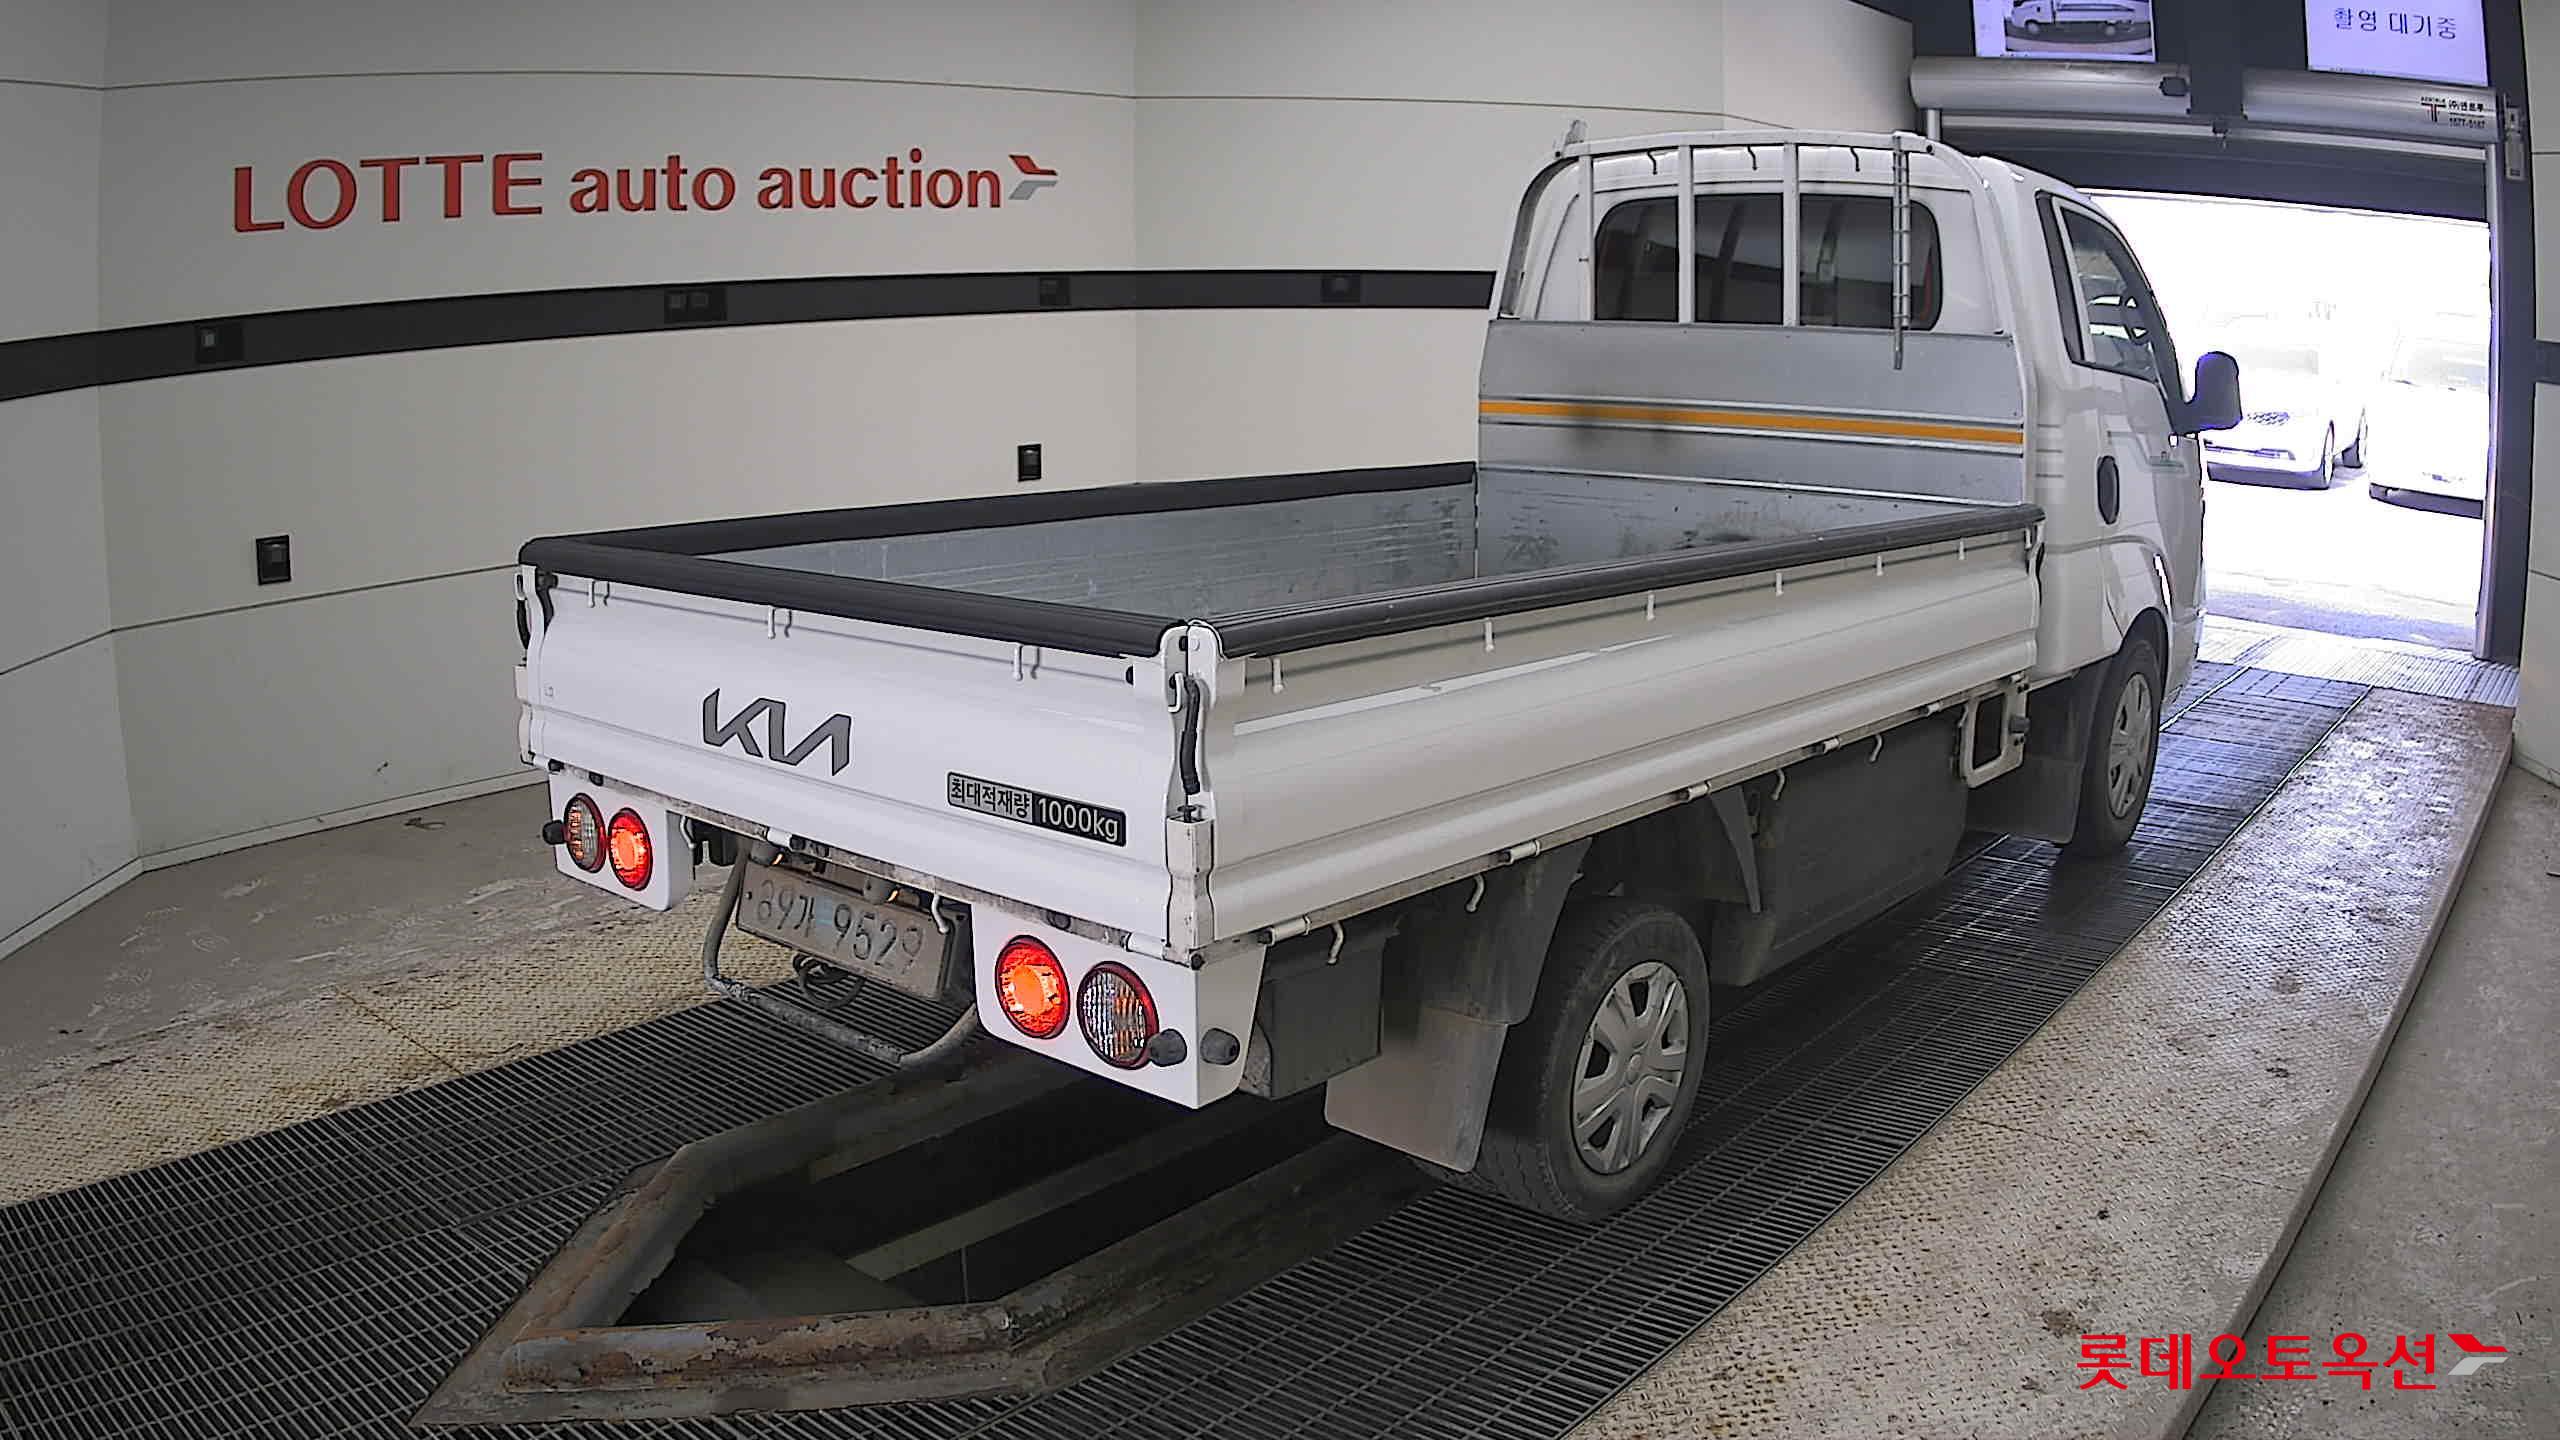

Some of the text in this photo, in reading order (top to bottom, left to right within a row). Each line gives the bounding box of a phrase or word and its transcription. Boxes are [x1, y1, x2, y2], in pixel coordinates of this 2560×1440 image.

[2388, 12, 2457, 40] 대기중
[233, 148, 1003, 233] LOTTE auto auction
[702, 687, 852, 777] KIA
[950, 777, 1121, 843] 최대적재량 1000kg
[833, 902, 926, 976] 9529
